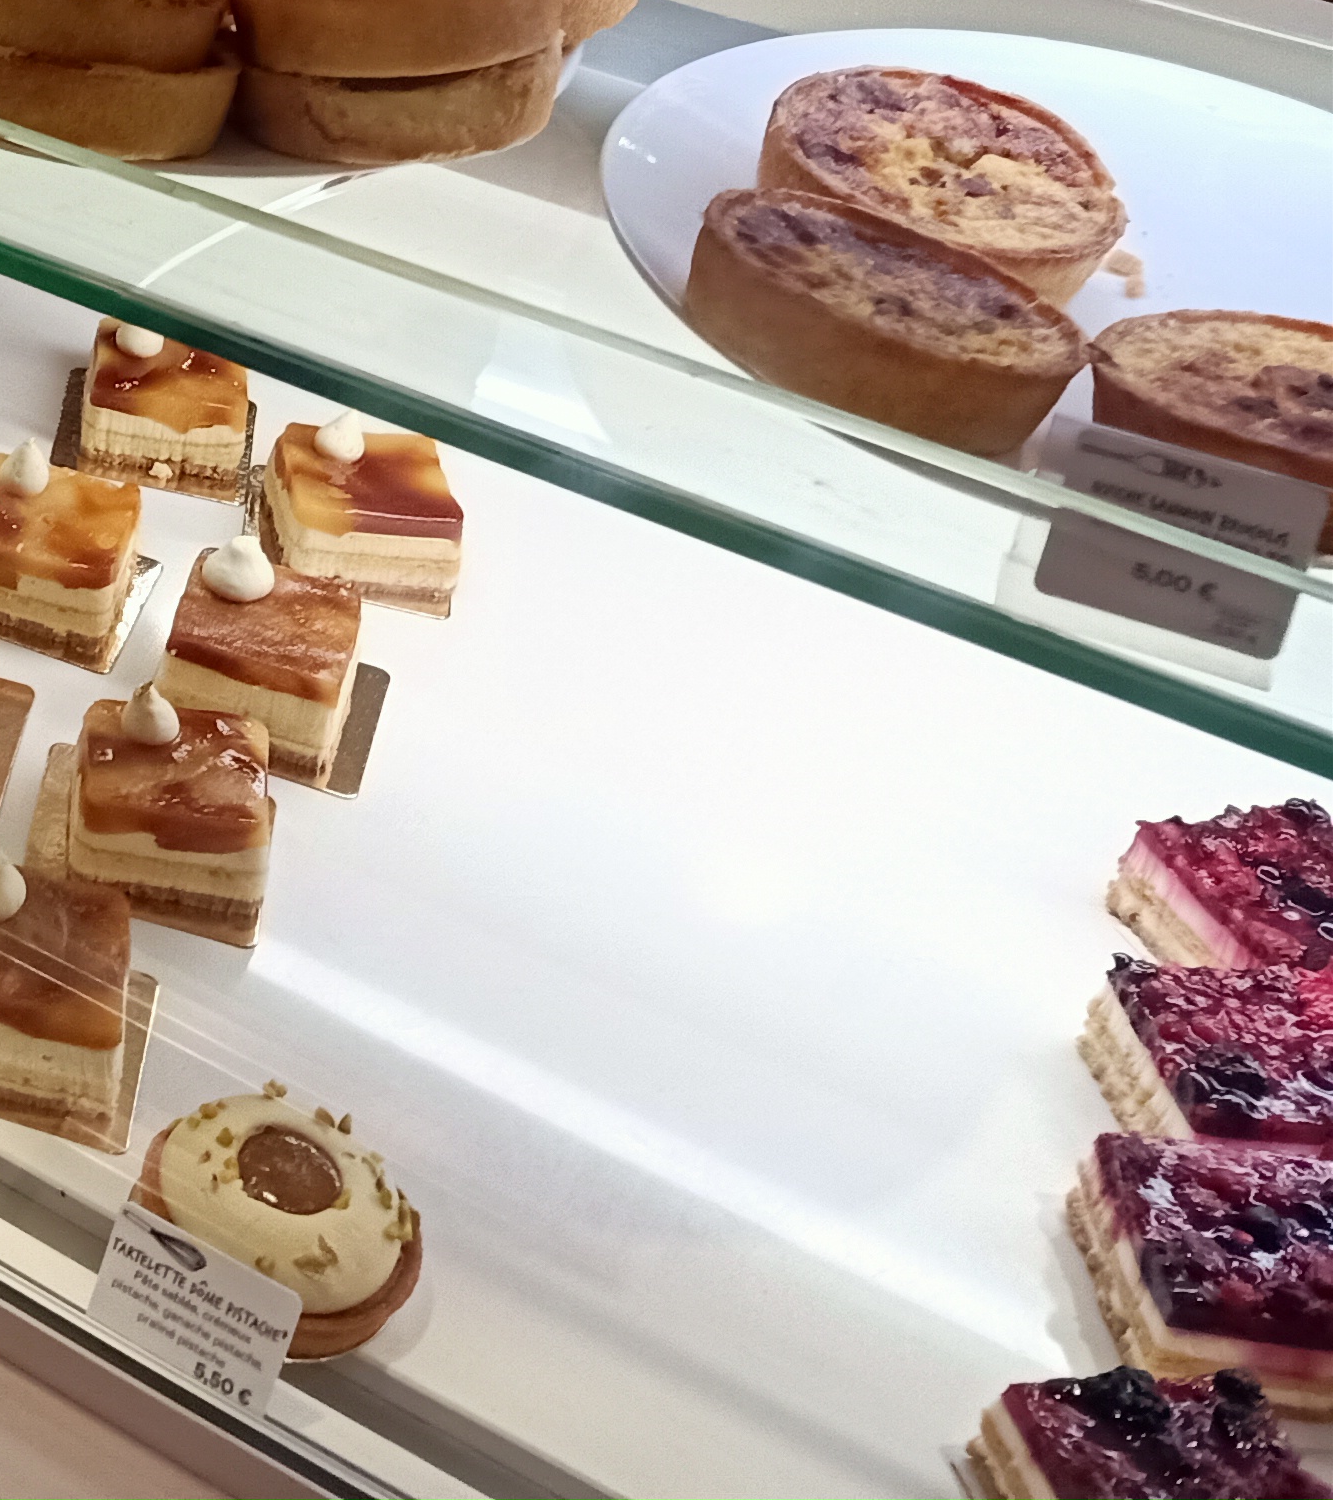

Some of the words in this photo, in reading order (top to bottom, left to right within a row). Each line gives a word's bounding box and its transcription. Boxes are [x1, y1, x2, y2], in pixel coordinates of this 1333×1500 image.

[113, 1237, 187, 1289] TARTELETTE
[190, 1280, 223, 1311] DÔME
[194, 1362, 234, 1396] 5,50
[238, 1388, 252, 1406] €
